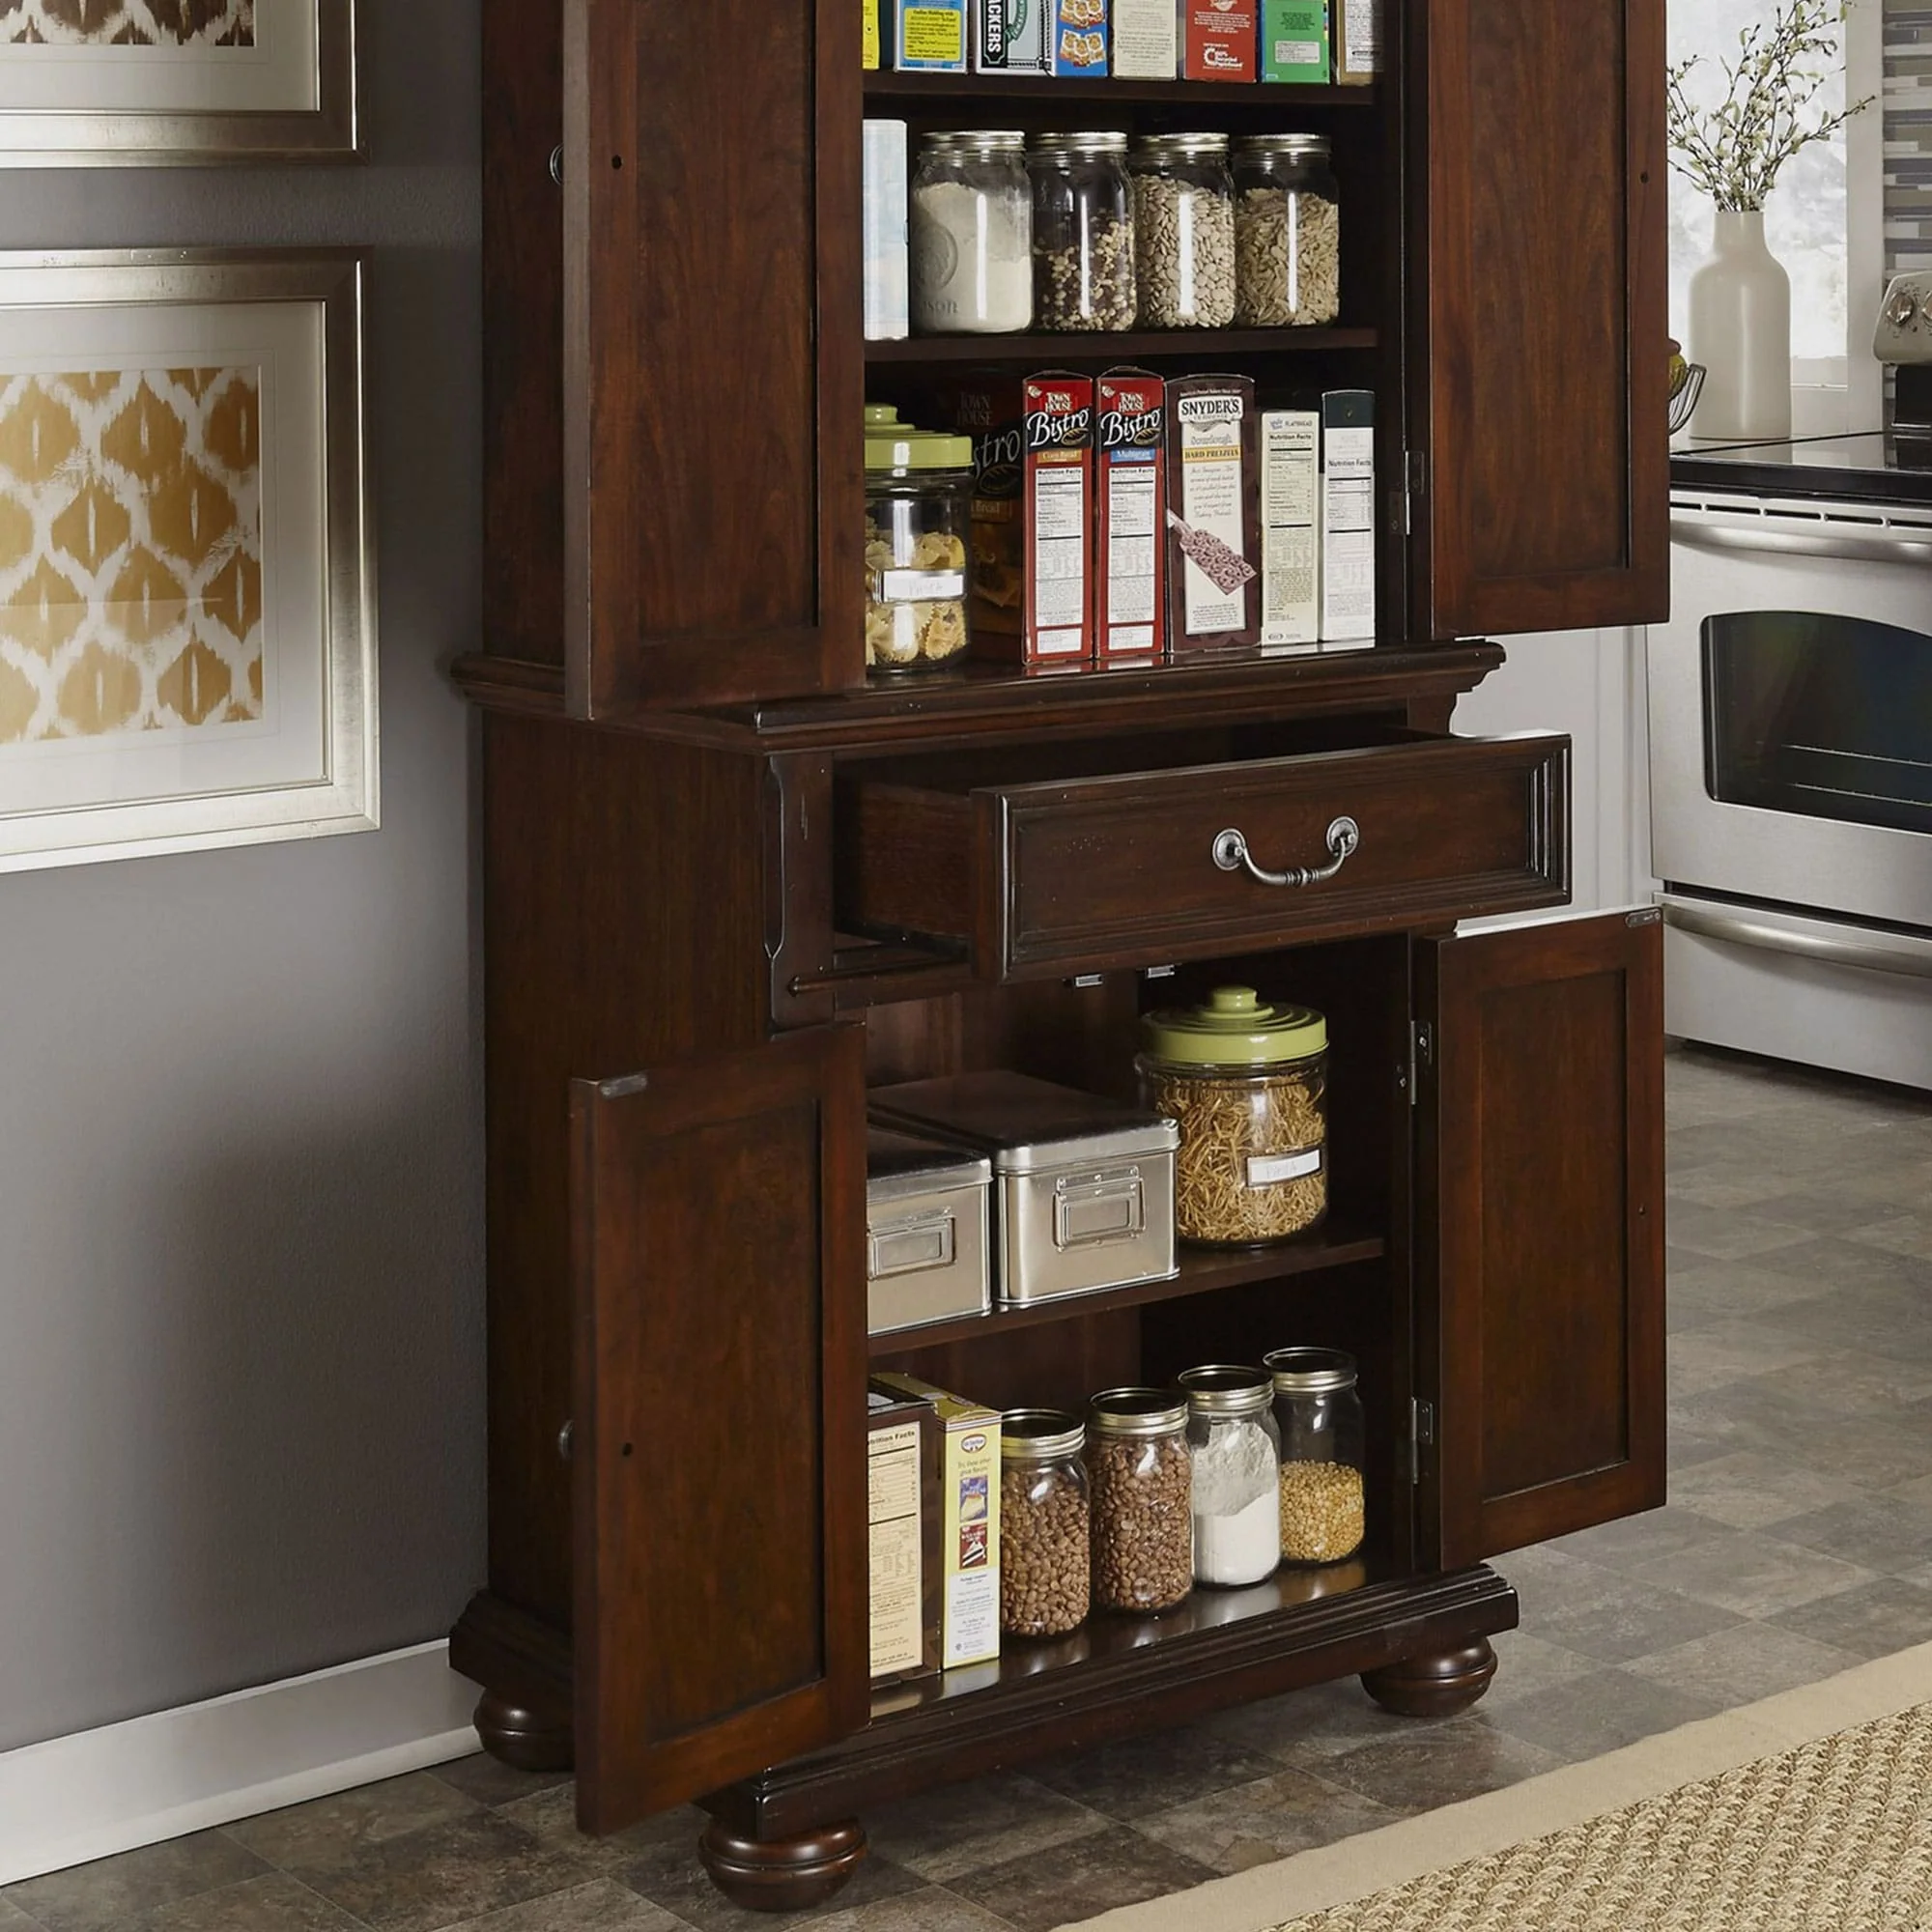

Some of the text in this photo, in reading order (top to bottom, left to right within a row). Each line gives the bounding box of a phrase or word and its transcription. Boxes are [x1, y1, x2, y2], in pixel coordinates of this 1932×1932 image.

[1046, 392, 1070, 404] TOWN
[1120, 392, 1143, 404] TOWN
[1045, 402, 1071, 413] HOUSE
[1119, 402, 1144, 413] HOUSE
[1181, 397, 1239, 415] SNYDER'S
[1027, 409, 1089, 446] Bistro
[1100, 409, 1160, 446] Bistro
[973, 430, 1020, 480] stro
[1184, 447, 1239, 459] HARD PRETZELS
[895, 1430, 916, 1440] Facts
